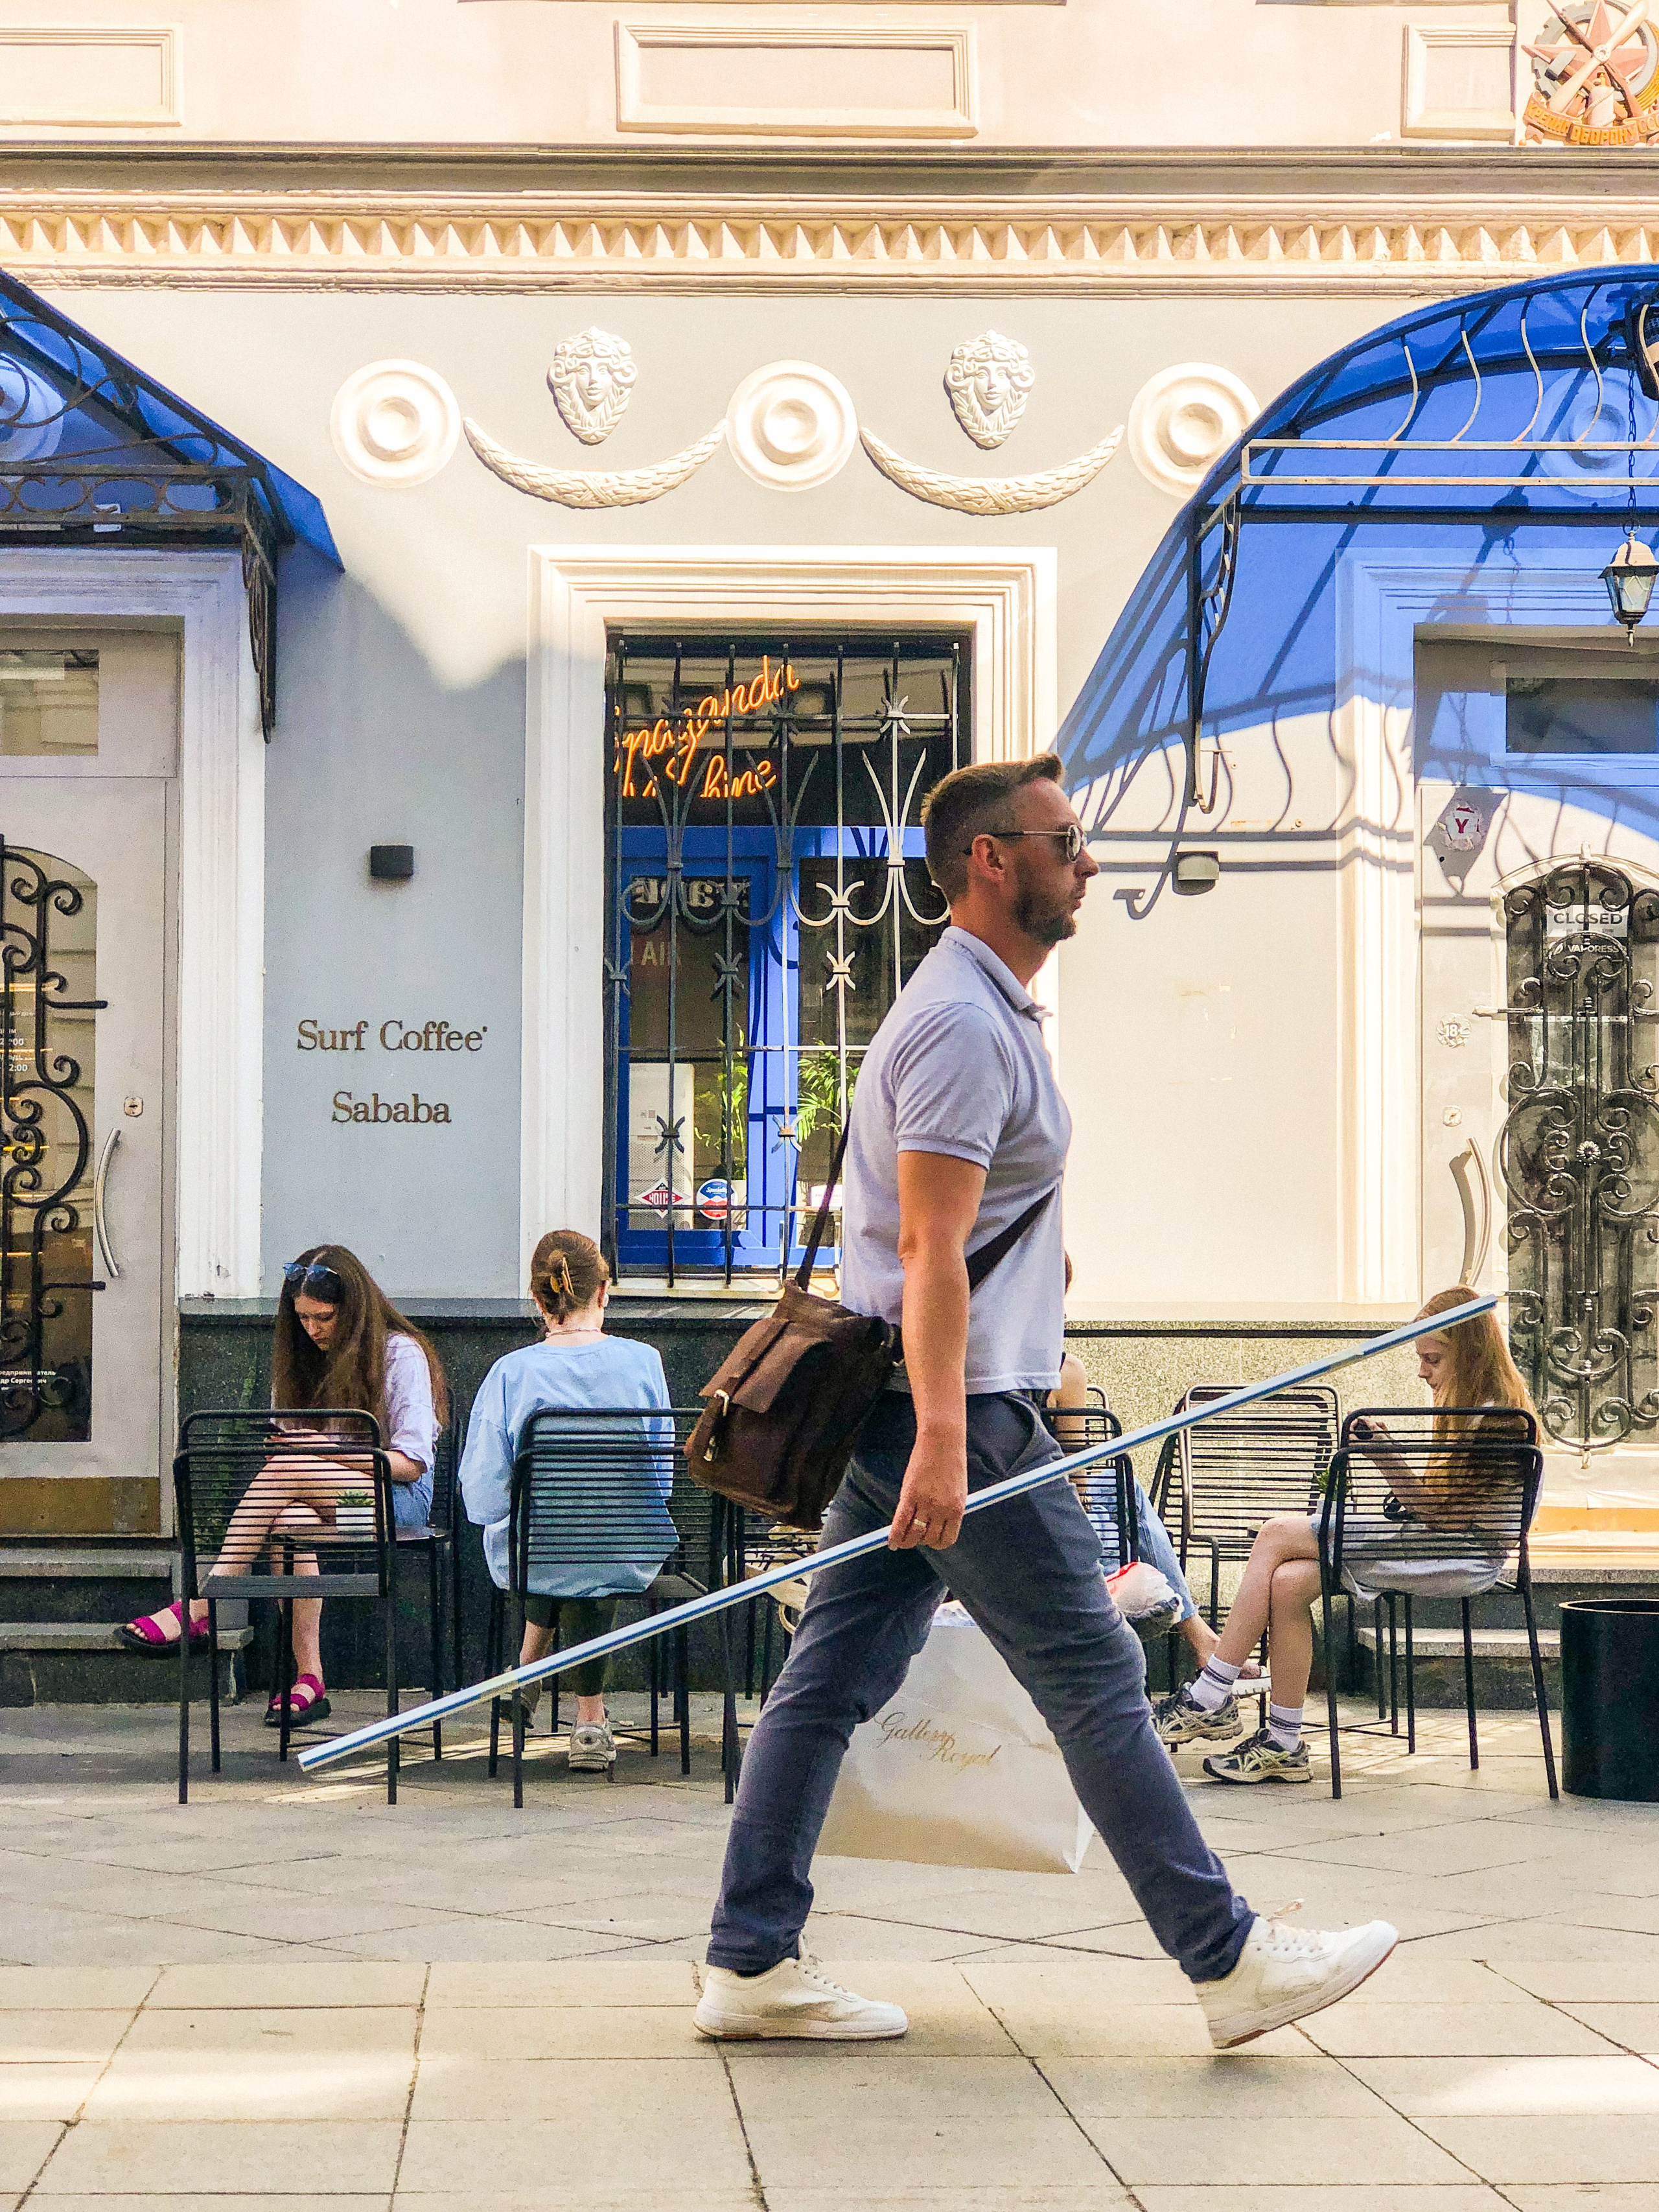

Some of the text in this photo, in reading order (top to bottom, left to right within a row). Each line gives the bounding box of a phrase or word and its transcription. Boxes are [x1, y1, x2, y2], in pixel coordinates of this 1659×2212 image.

[1570, 125, 1634, 146] ОБОРОНУ
[1553, 913, 1623, 924] CLOSED
[1568, 944, 1620, 953] VAPORESS
[297, 1019, 369, 1051] Surf
[332, 1091, 452, 1123] Sababa
